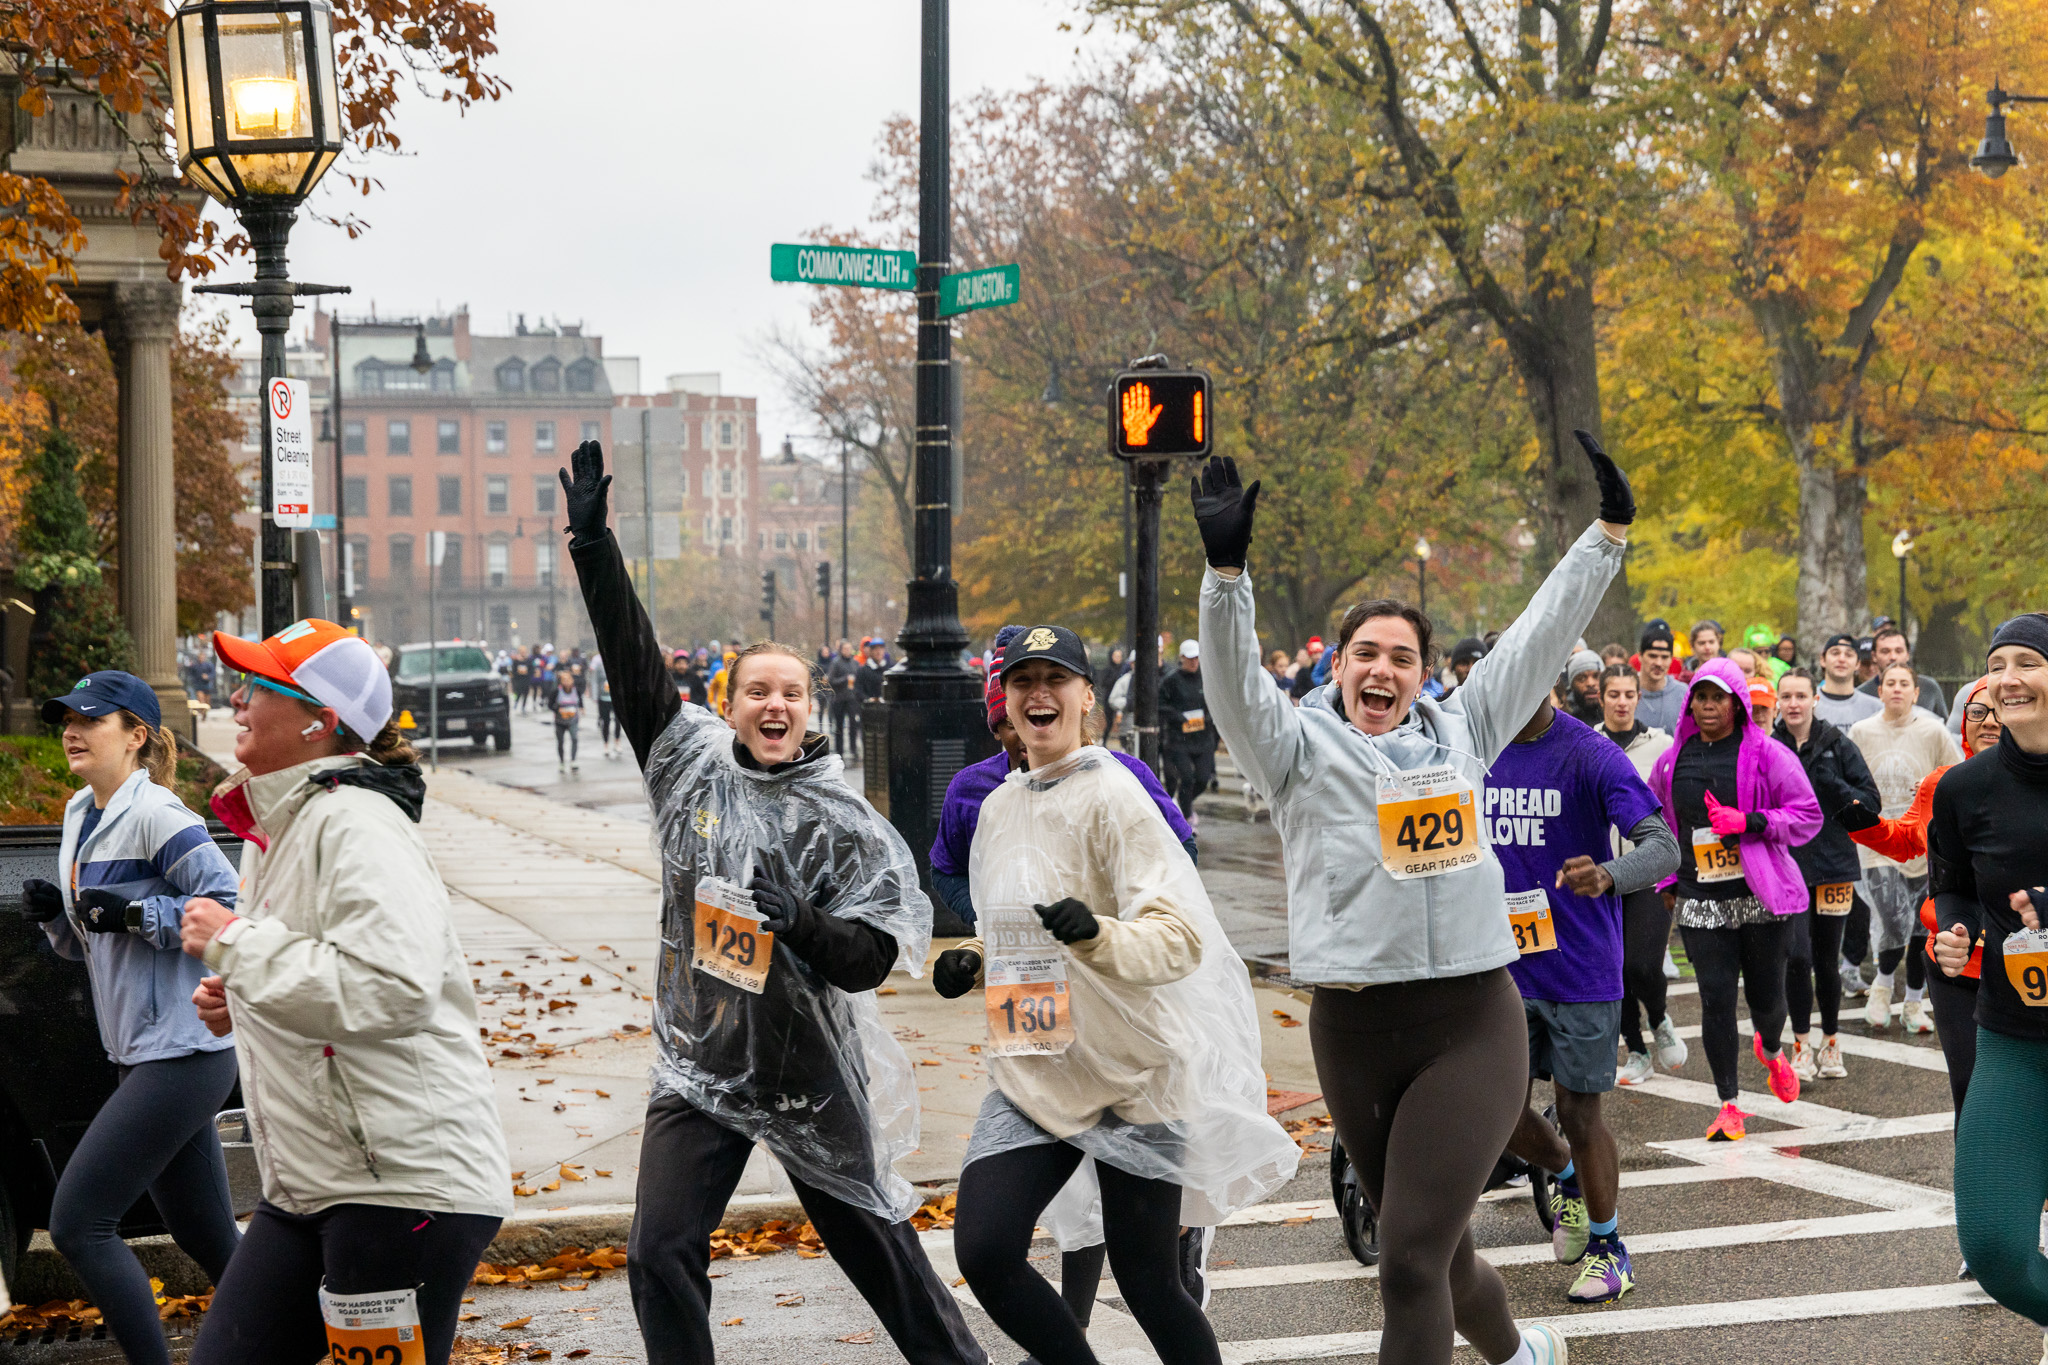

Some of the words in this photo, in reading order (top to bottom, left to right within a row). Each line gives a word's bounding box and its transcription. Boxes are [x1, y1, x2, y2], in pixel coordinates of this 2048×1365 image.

[798, 249, 901, 284] COMMONWEALTH
[956, 271, 1006, 307] ARLINGTON
[276, 427, 302, 443] Street
[277, 446, 310, 467] Cleaning
[1402, 774, 1421, 782] CAMP
[1421, 770, 1448, 779] HARBOR
[1412, 779, 1431, 787] ROAD
[1484, 787, 1562, 817] PREAD
[1397, 808, 1464, 853] 429
[1485, 817, 1546, 847] LOVE
[1405, 862, 1437, 874] GEAR
[1439, 857, 1458, 870] TAG
[1460, 853, 1477, 864] 429
[1704, 847, 1740, 869] 155
[706, 919, 757, 967] 129
[1019, 931, 1050, 946] RAC
[706, 960, 725, 977] GEAR
[725, 970, 741, 984] TAG
[744, 976, 759, 989] 129
[2023, 965, 2048, 1001] 9
[1000, 995, 1057, 1034] 130
[1005, 1043, 1033, 1053] GEAR
[1033, 1041, 1053, 1051] TAG
[329, 1300, 347, 1308] CAMP
[348, 1299, 382, 1308] HARBOR
[384, 1297, 406, 1305] VIEW
[338, 1307, 360, 1315] ROAD
[361, 1306, 383, 1314] RACE
[385, 1305, 395, 1313] 5K
